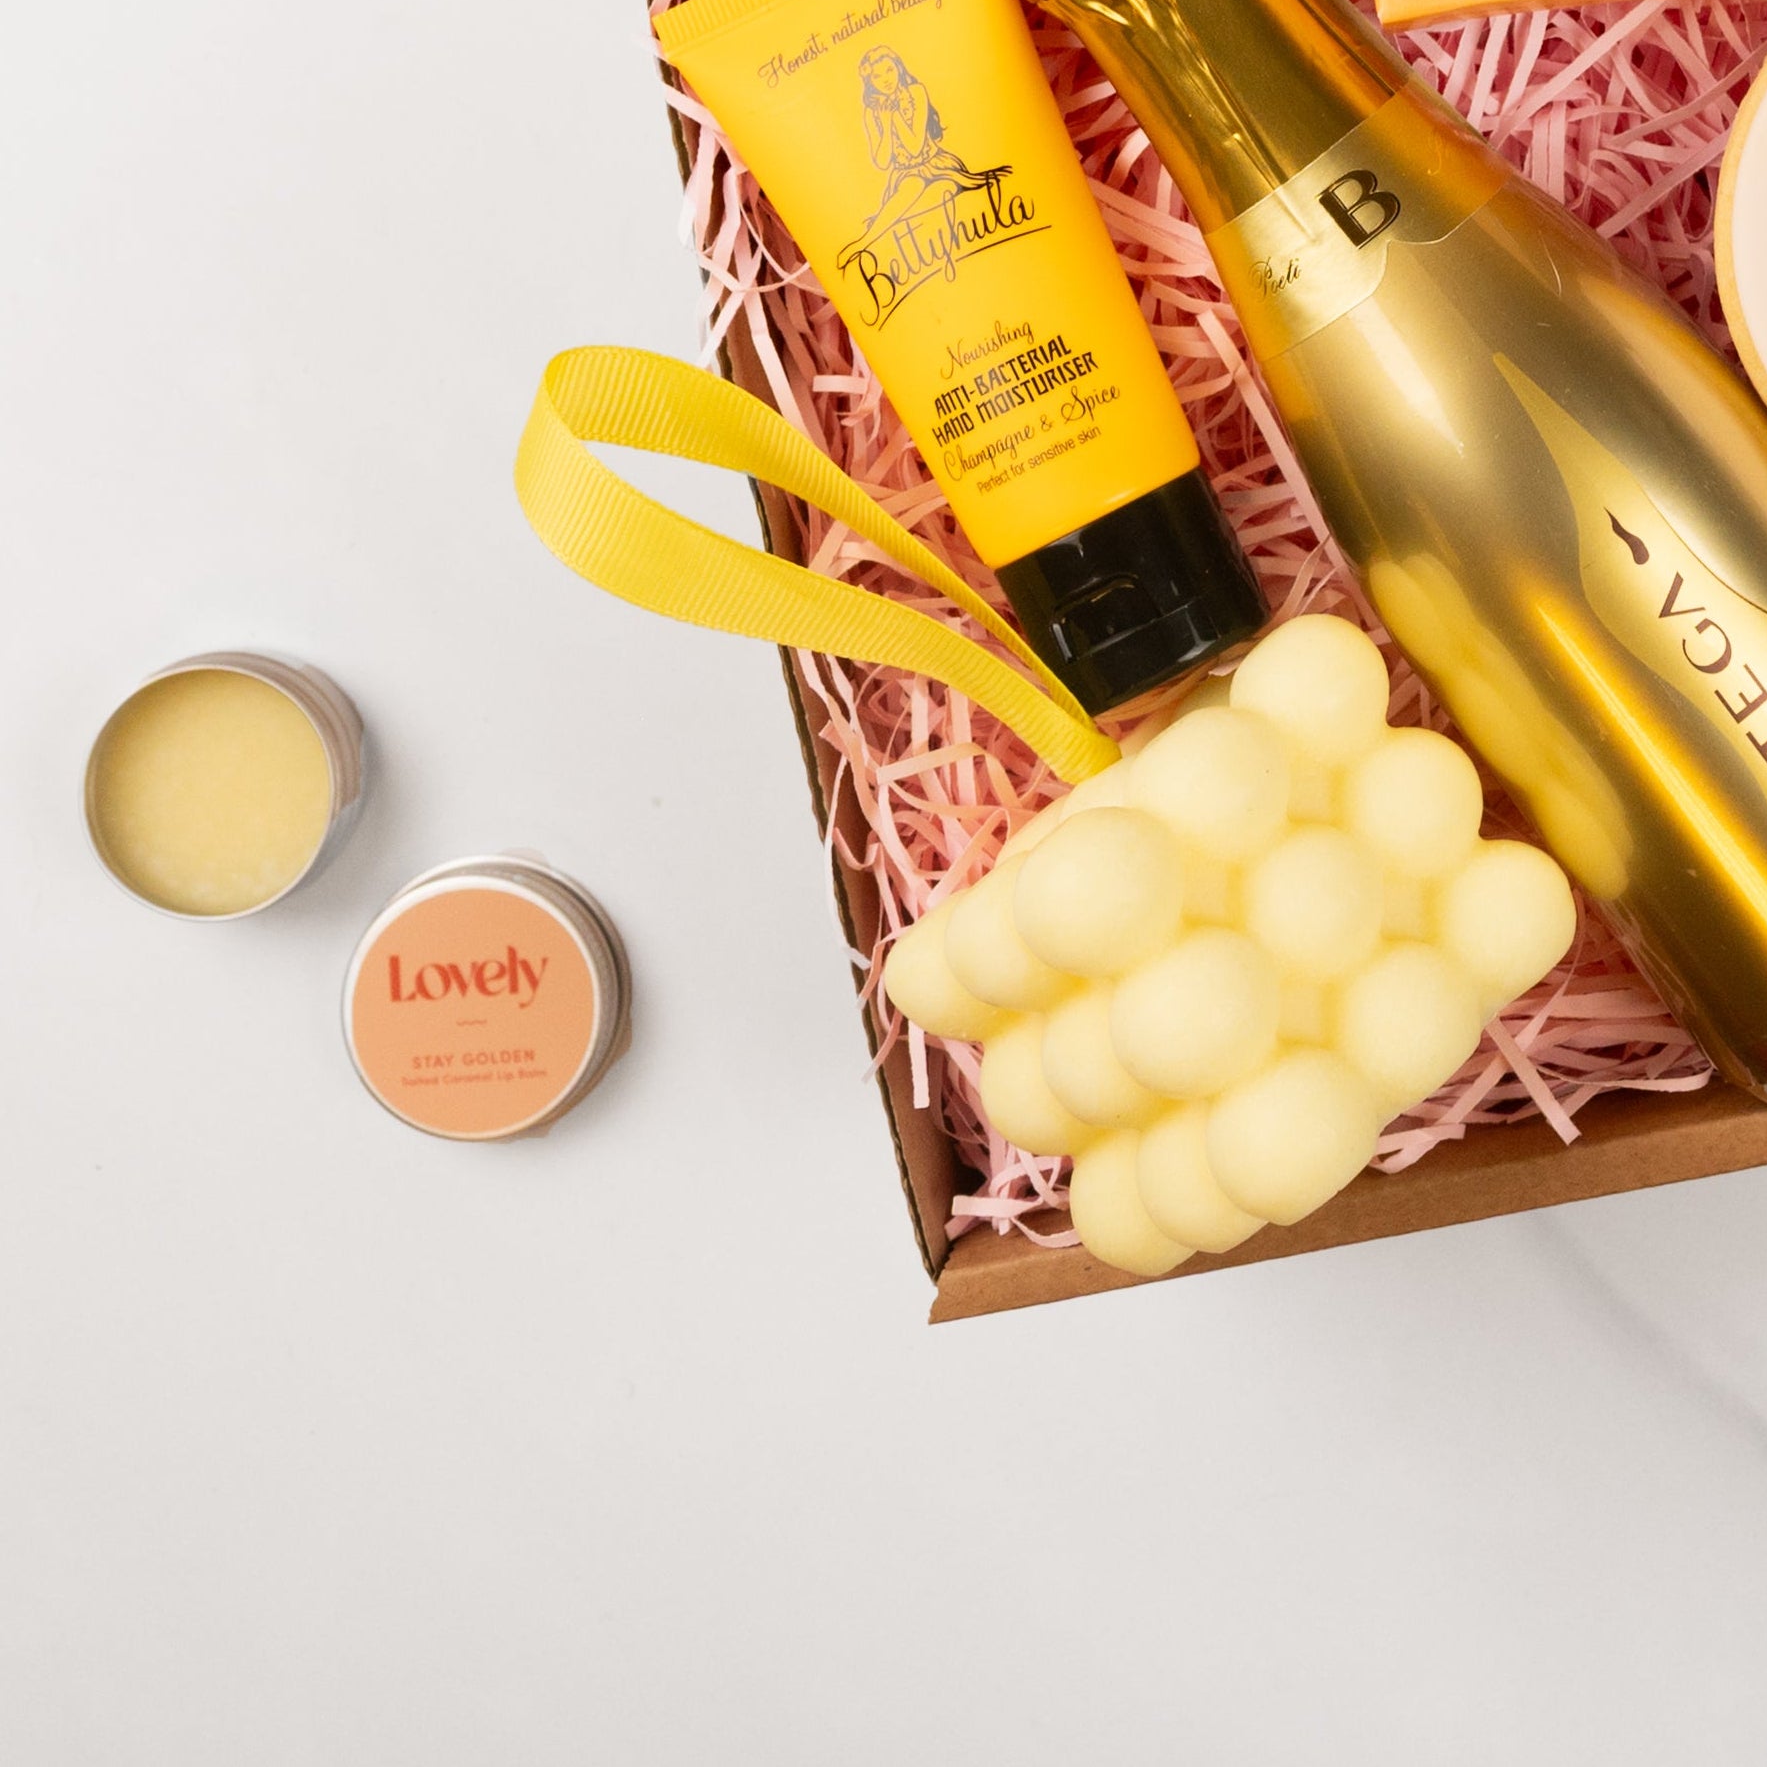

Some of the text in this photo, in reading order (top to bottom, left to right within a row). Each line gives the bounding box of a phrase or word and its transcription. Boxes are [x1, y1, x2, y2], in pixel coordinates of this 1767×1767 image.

[757, 33, 829, 88] Honest,
[1317, 169, 1401, 250] B
[934, 334, 1072, 419] ANTI-BACTERIAL
[940, 320, 1035, 380] Nourishing
[932, 351, 1099, 448] HAND MOISTURISER
[944, 385, 1121, 482] Champagne & Spice
[976, 425, 1102, 496] Perfect for sensitive skin
[388, 945, 549, 1009] Lovely
[412, 1049, 536, 1070] STAY GOLDEN
